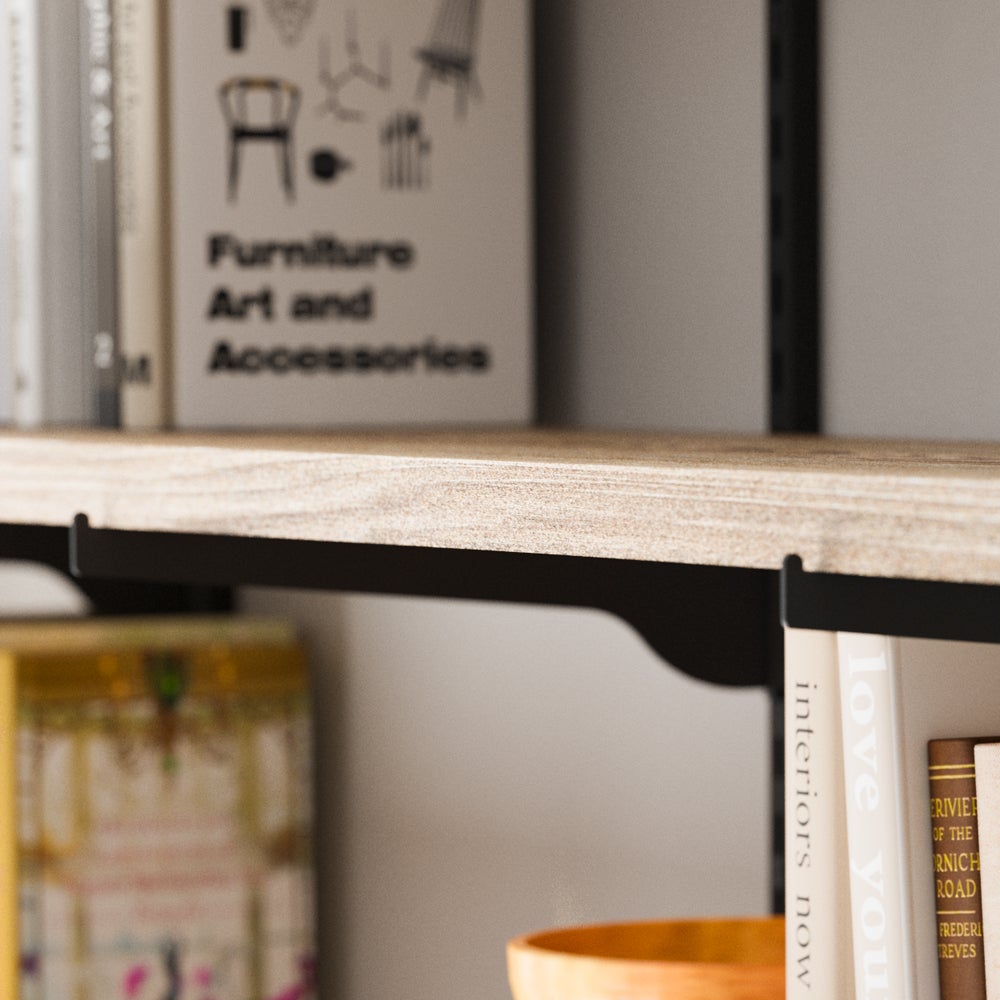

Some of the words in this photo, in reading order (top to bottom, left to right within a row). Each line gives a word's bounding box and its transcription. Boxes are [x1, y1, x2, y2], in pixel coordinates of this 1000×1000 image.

[207, 233, 414, 269] Furniture
[208, 286, 273, 320] Art
[291, 286, 373, 320] and
[208, 339, 490, 373] Accessories
[848, 651, 888, 812] love
[795, 680, 818, 869] interiors
[933, 826, 945, 841] OF
[949, 825, 973, 841] THE
[937, 878, 977, 899] ROAD
[796, 895, 812, 990] now
